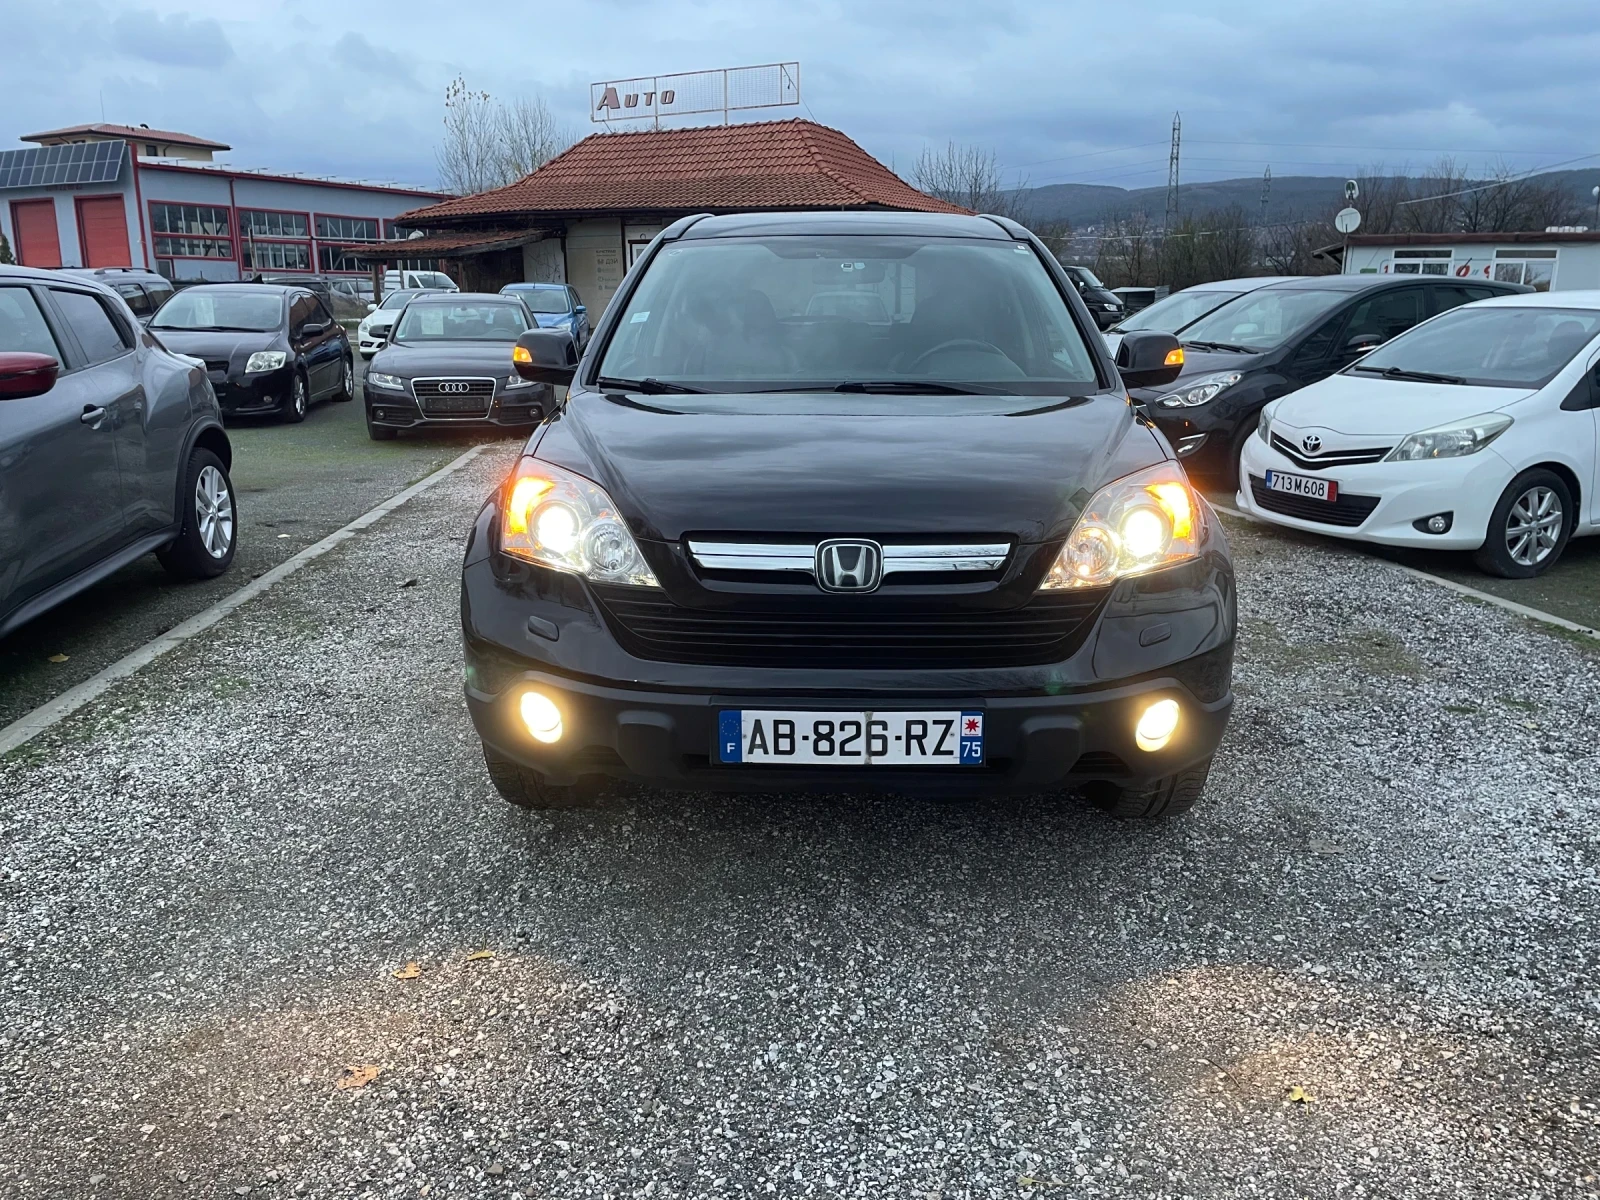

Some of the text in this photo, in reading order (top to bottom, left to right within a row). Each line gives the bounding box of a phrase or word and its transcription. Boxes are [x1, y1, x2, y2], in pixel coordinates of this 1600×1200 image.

[1272, 473, 1325, 497] 713M608
[747, 718, 955, 757] AB-826-RZ
[726, 742, 736, 754] F
[961, 741, 981, 758] 75
